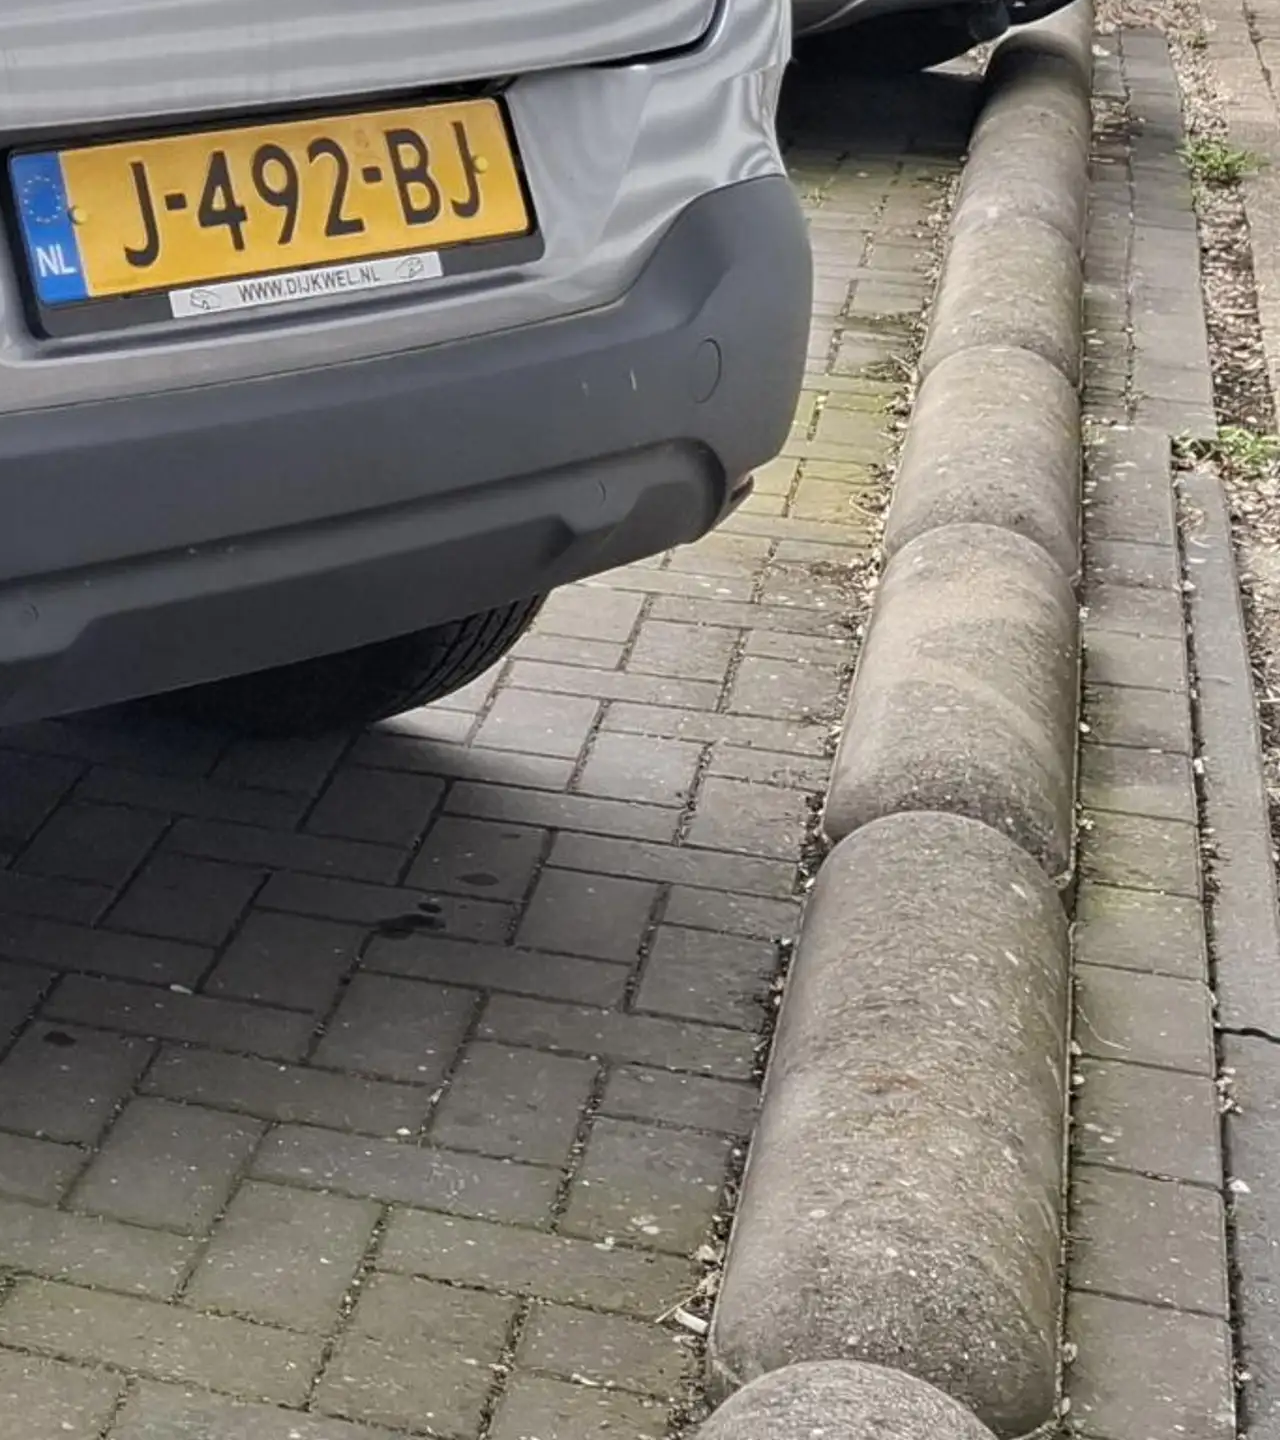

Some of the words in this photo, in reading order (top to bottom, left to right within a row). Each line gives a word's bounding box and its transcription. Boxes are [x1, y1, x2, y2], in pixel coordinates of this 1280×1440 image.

[36, 246, 77, 279] NL
[123, 120, 481, 269] J-492-BJ
[238, 266, 382, 304] WWW.DIJKWEL.NL
